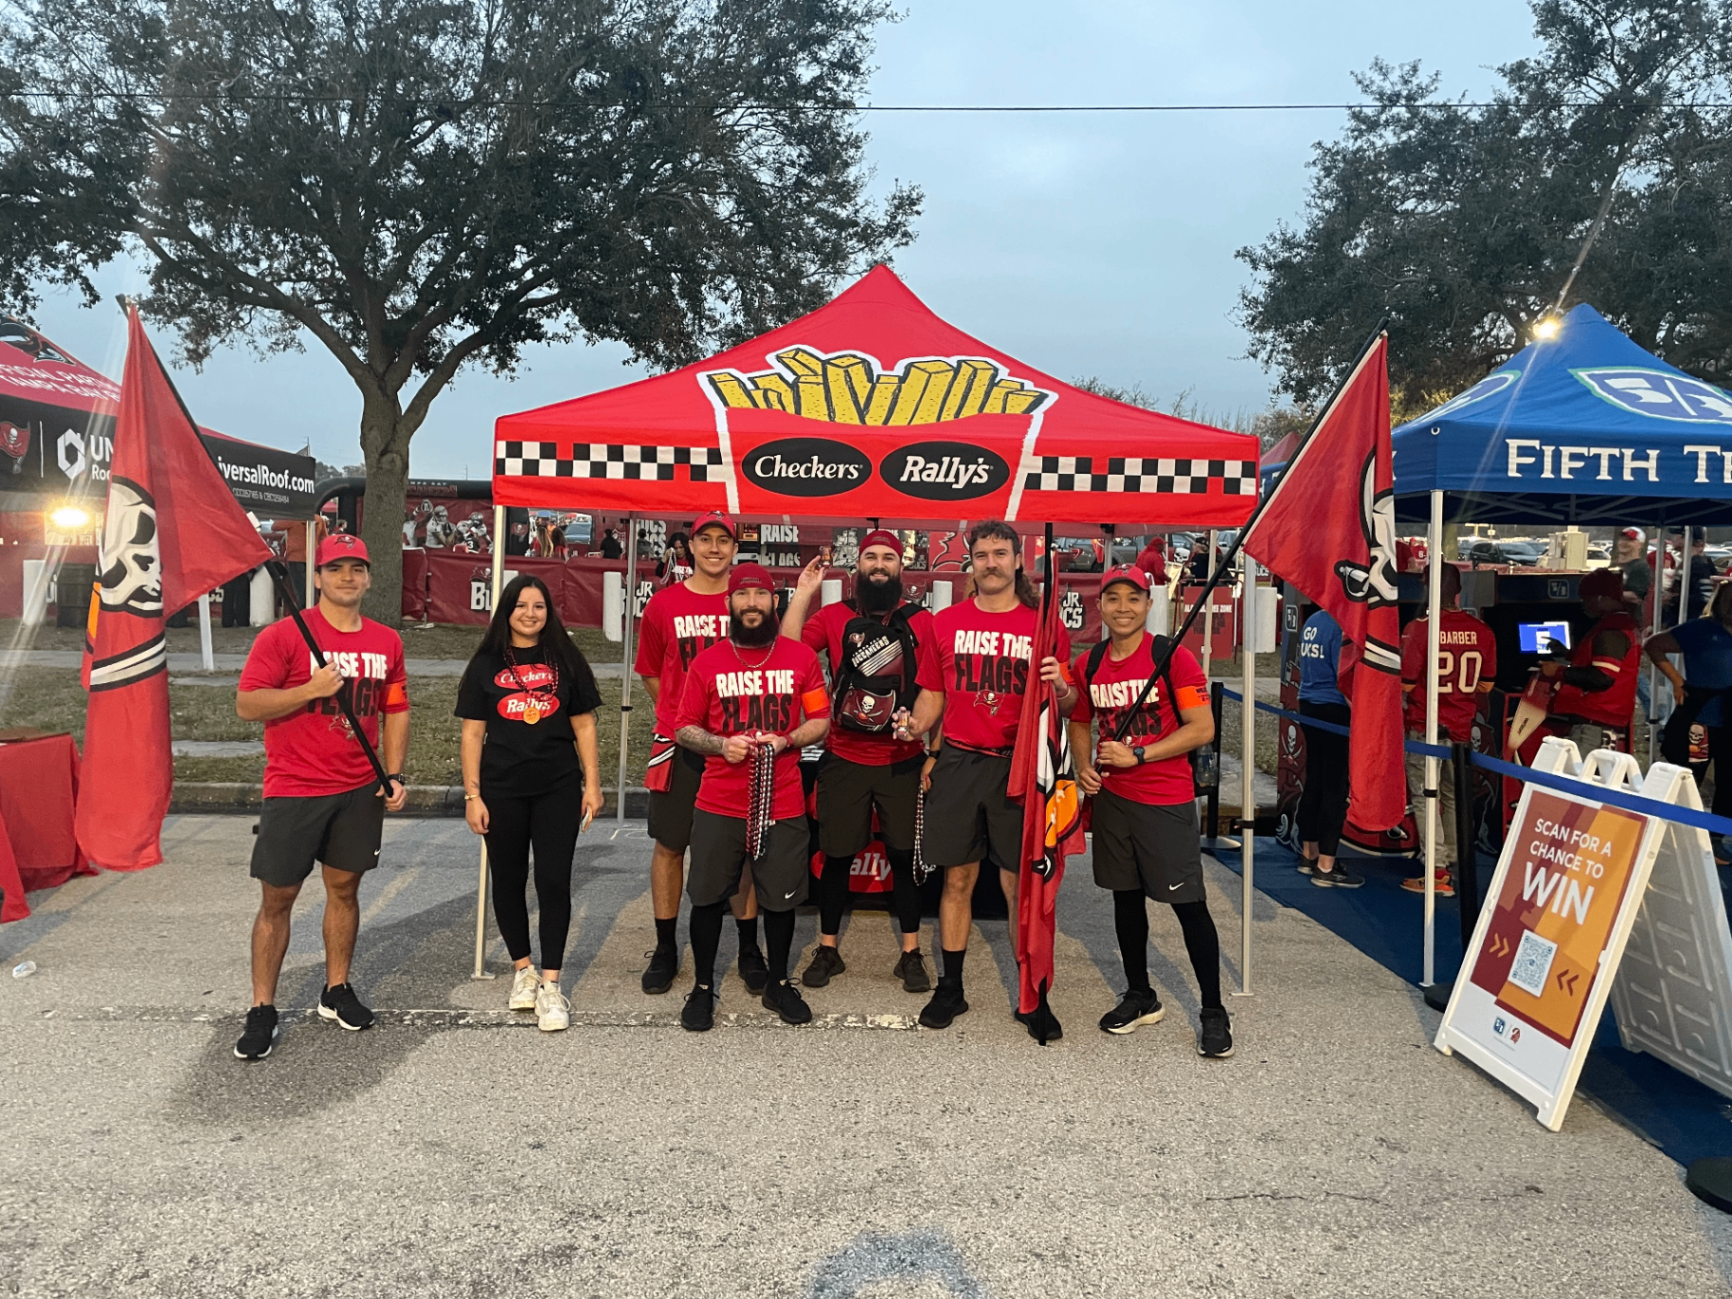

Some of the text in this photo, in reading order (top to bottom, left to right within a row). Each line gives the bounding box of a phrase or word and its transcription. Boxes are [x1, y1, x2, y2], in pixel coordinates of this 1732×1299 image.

[90, 434, 114, 462] UN
[1505, 438, 1660, 482] FIFTH
[217, 455, 316, 494] iversalRoof.com
[754, 454, 861, 480] Checkers
[899, 455, 990, 489] Rally's
[760, 523, 799, 545] RAISE
[673, 615, 717, 639] RAISE
[1303, 626, 1318, 641] GO
[1440, 631, 1478, 645] BARBER
[954, 629, 1032, 660] RAISE THE
[361, 652, 387, 680] THE
[954, 653, 1030, 695] FLAGS
[1438, 651, 1483, 693] 20
[715, 669, 794, 698] RAISE THE
[720, 693, 793, 733] FLAGS
[1534, 817, 1612, 858] SCAN FOR A
[849, 852, 892, 881] ally
[1529, 840, 1605, 879] CHANCE TO
[1522, 861, 1595, 926] WIN
